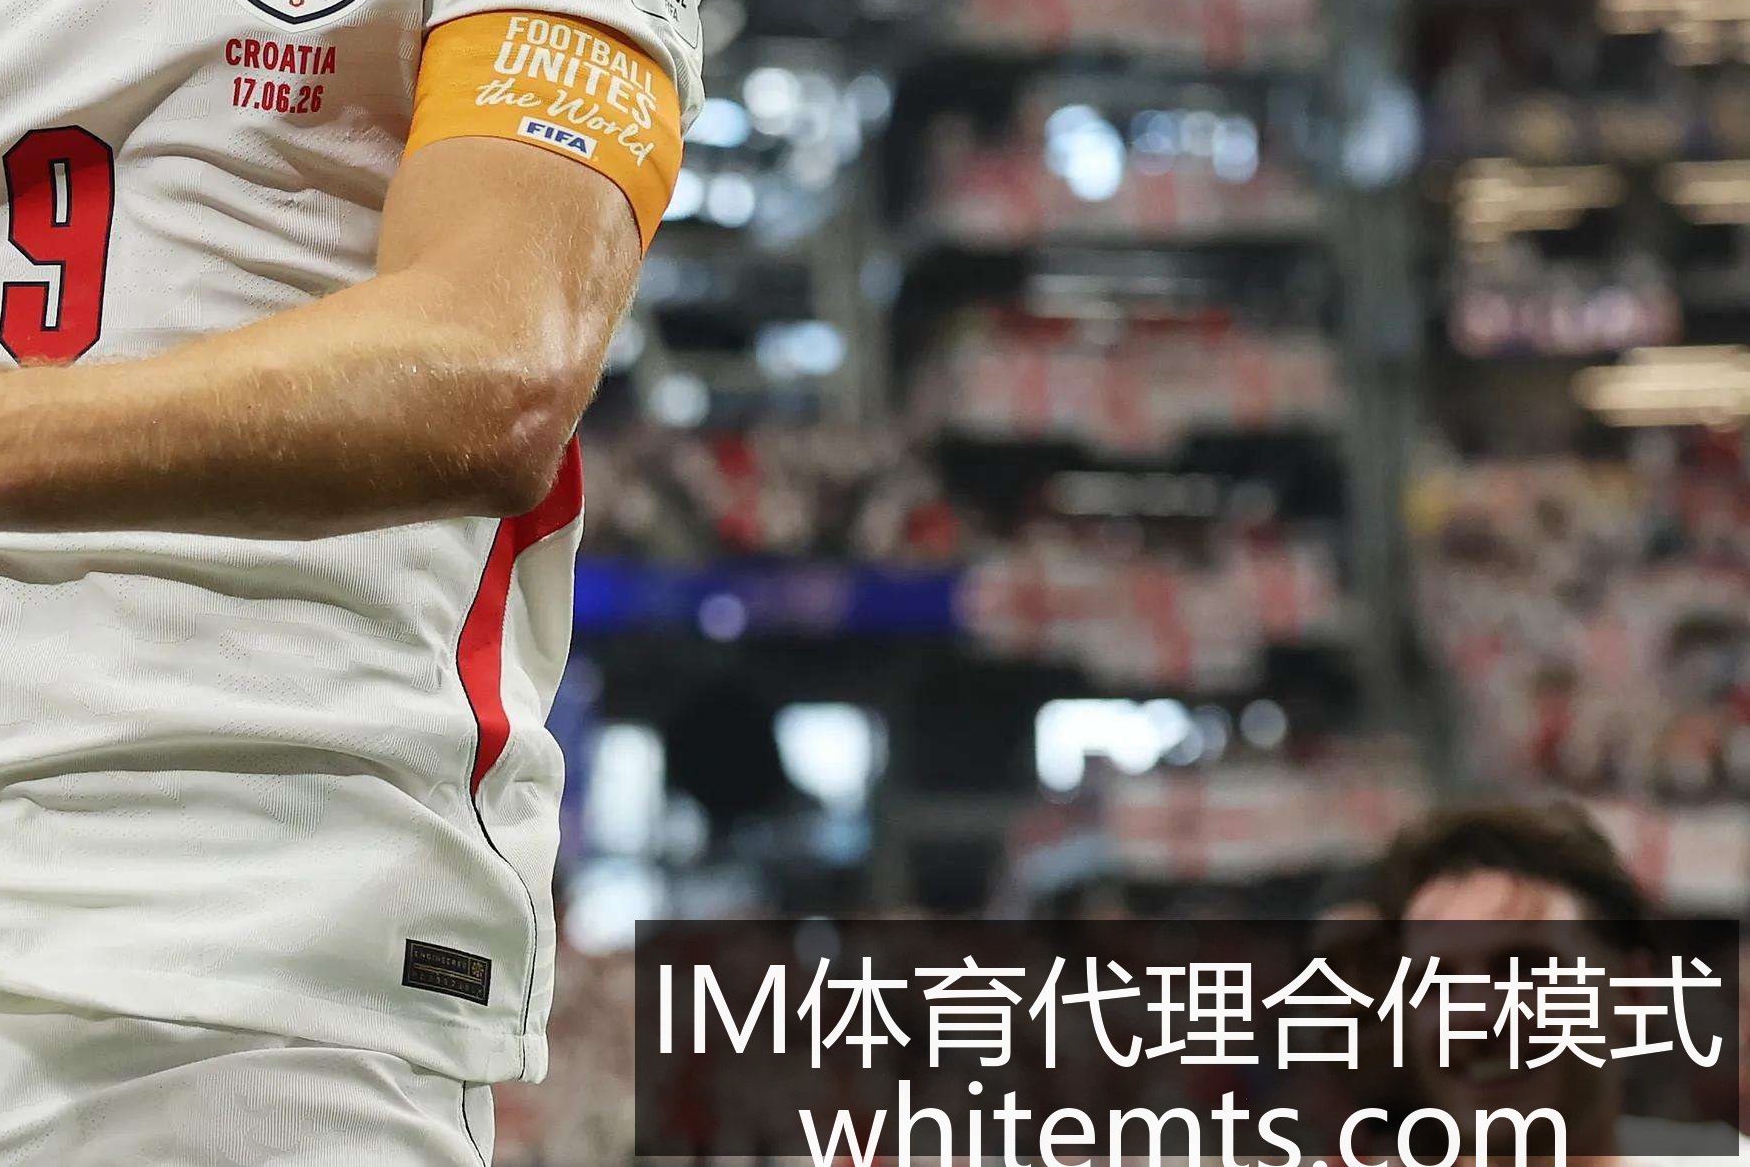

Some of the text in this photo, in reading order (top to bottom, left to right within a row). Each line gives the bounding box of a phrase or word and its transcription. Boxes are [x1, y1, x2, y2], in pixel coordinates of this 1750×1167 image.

[225, 38, 337, 75] CROATIA
[493, 41, 657, 129] UNITES
[506, 16, 657, 102] FOOTBALL
[232, 76, 325, 114] 17.06.26
[474, 78, 655, 168] the World
[526, 121, 588, 154] FIFA
